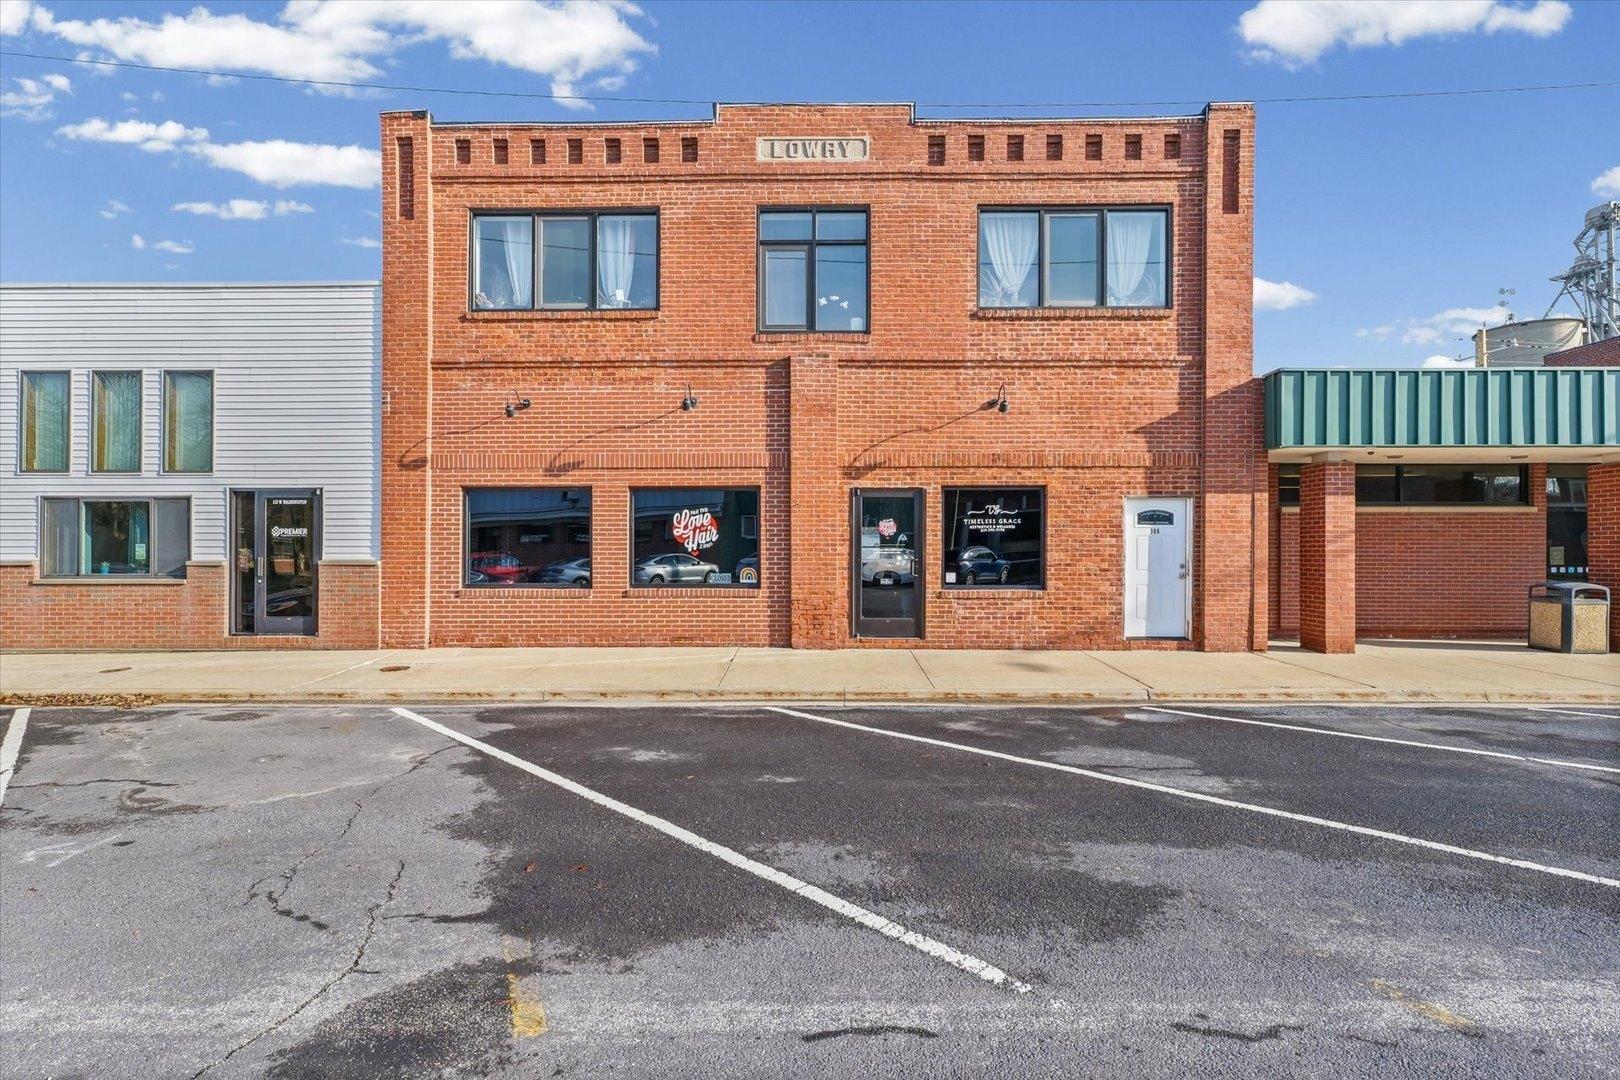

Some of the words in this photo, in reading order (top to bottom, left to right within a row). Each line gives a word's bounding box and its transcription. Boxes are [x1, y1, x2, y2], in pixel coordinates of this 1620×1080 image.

[769, 141, 849, 158] LOWRY
[673, 510, 711, 536] Love
[684, 526, 718, 552] Hair
